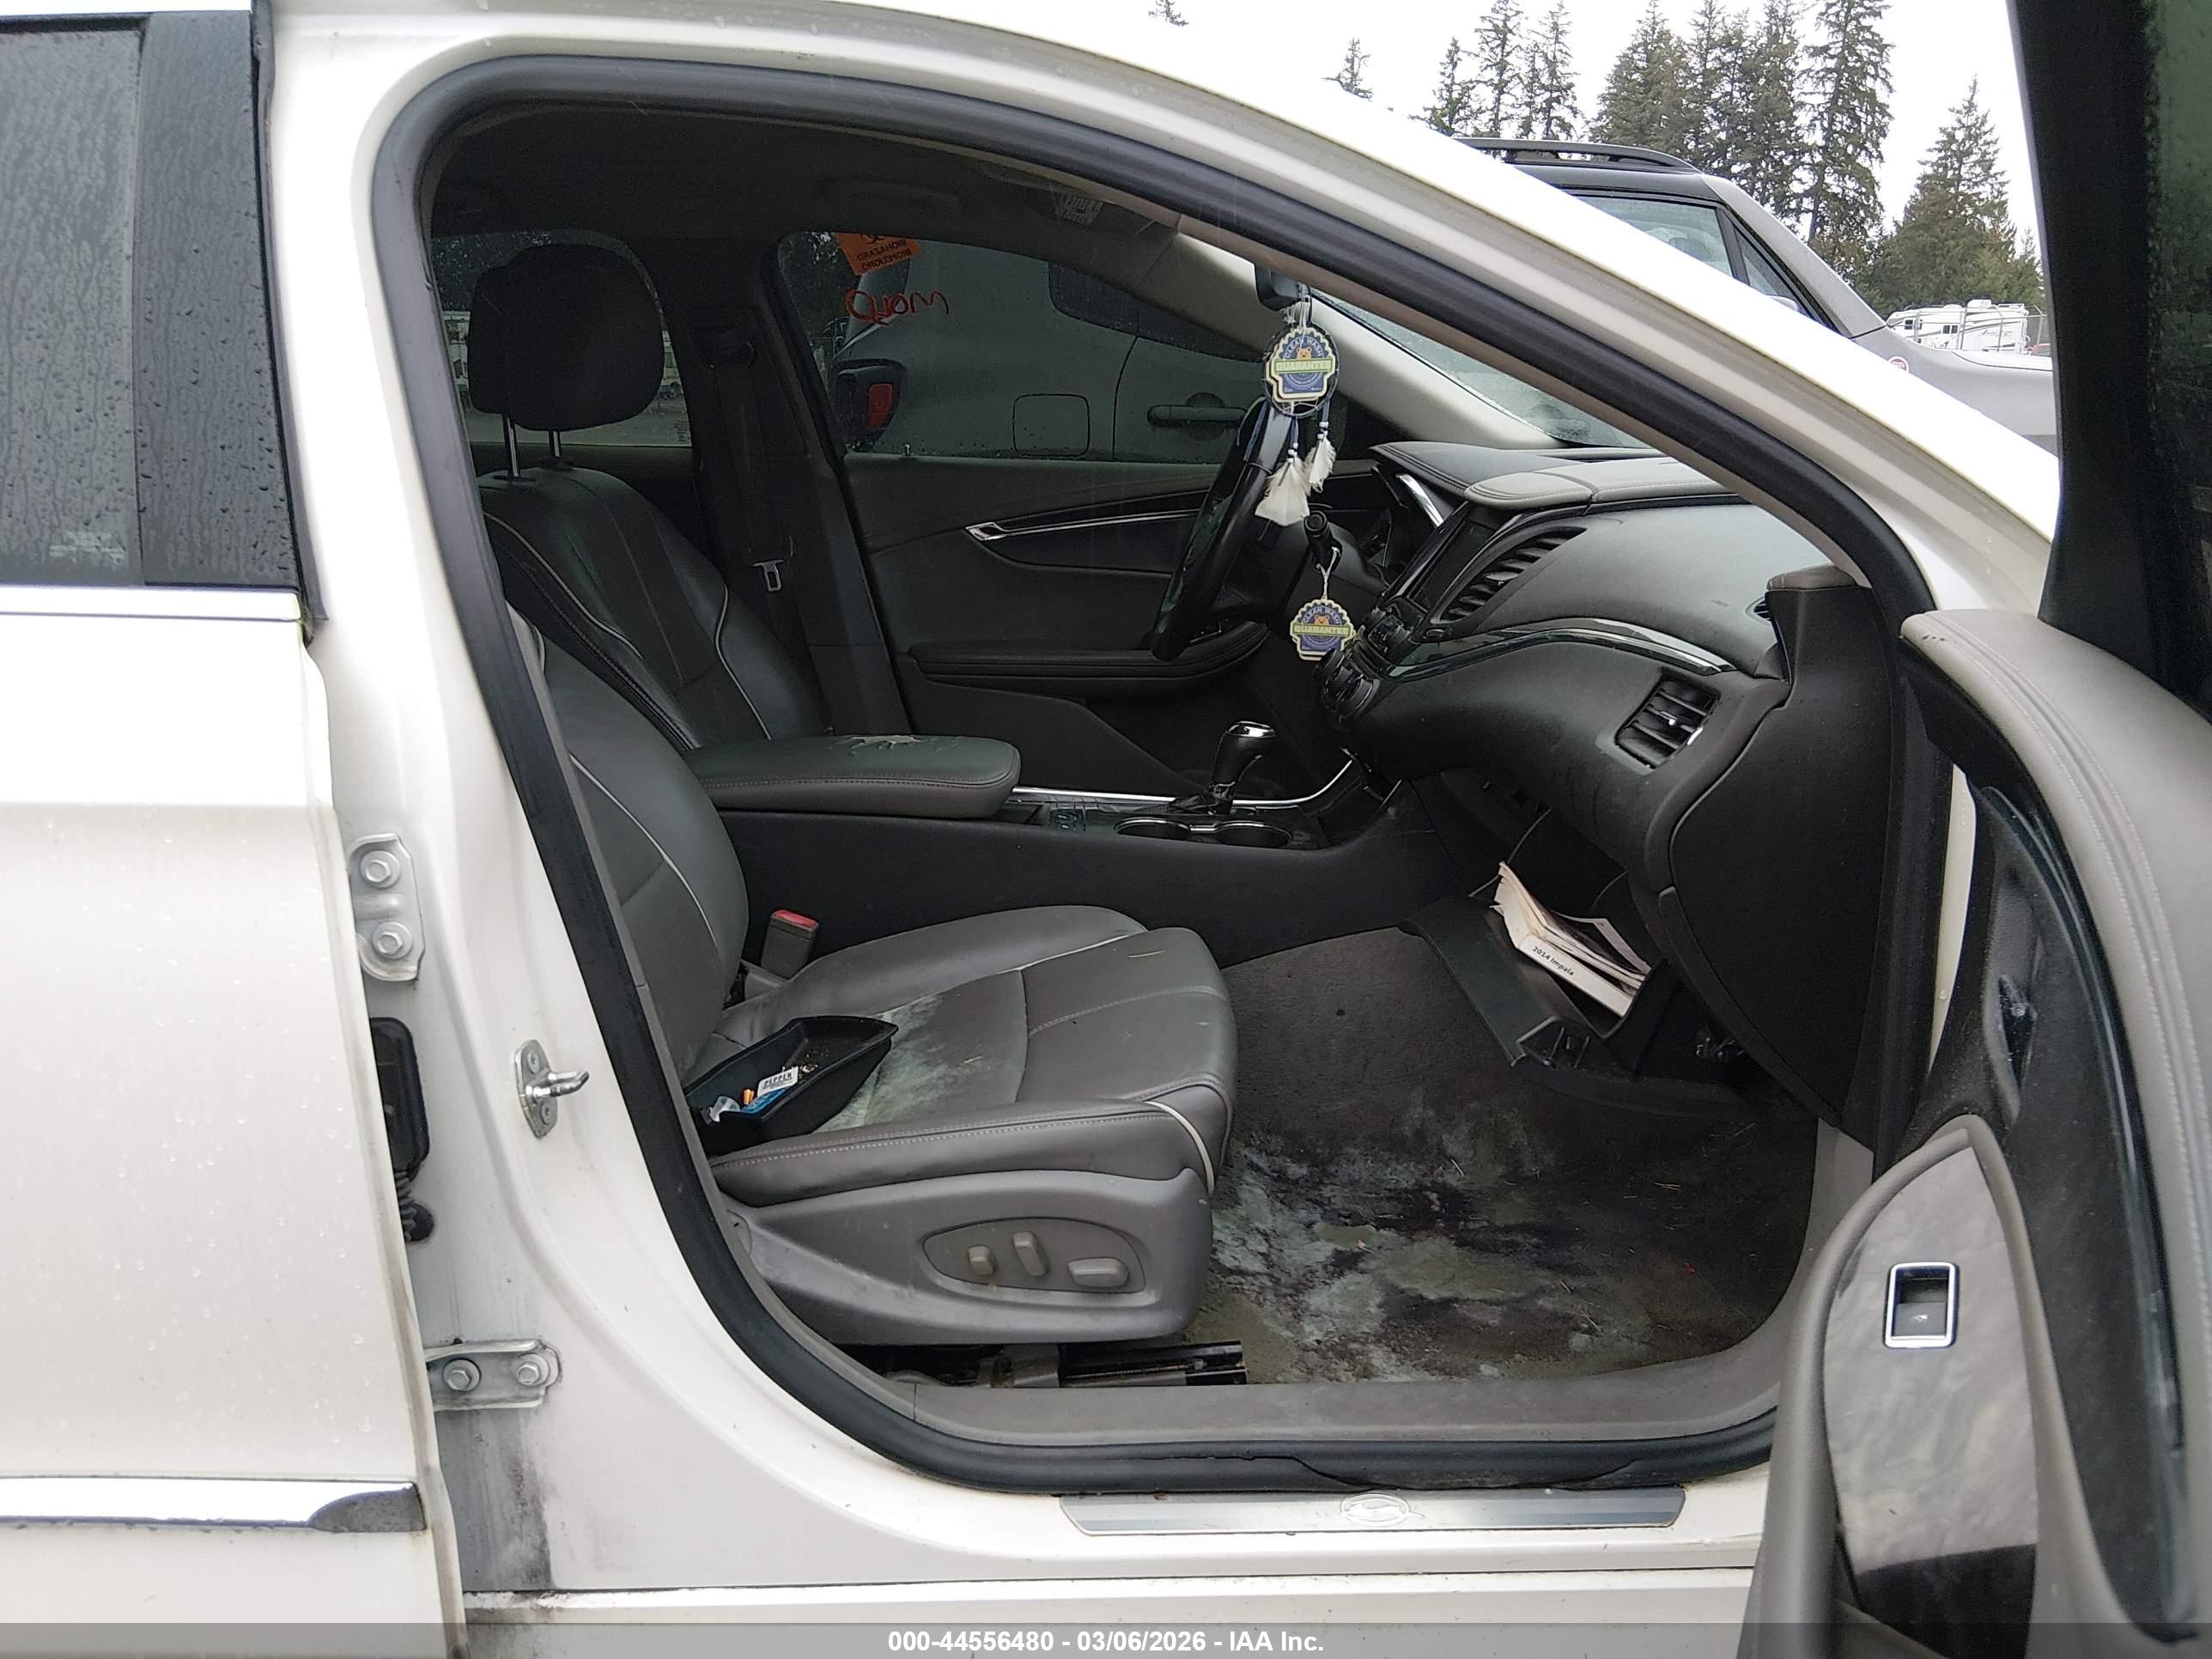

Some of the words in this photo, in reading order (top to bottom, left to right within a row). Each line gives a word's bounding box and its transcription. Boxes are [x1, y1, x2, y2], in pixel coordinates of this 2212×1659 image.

[1285, 338, 1304, 358] CLEAN
[1307, 338, 1322, 356] WASH
[1304, 607, 1322, 623] CLEAN
[1325, 609, 1340, 624] WASH
[1532, 945, 1551, 960] 2014
[764, 1073, 792, 1086] PEPPER
